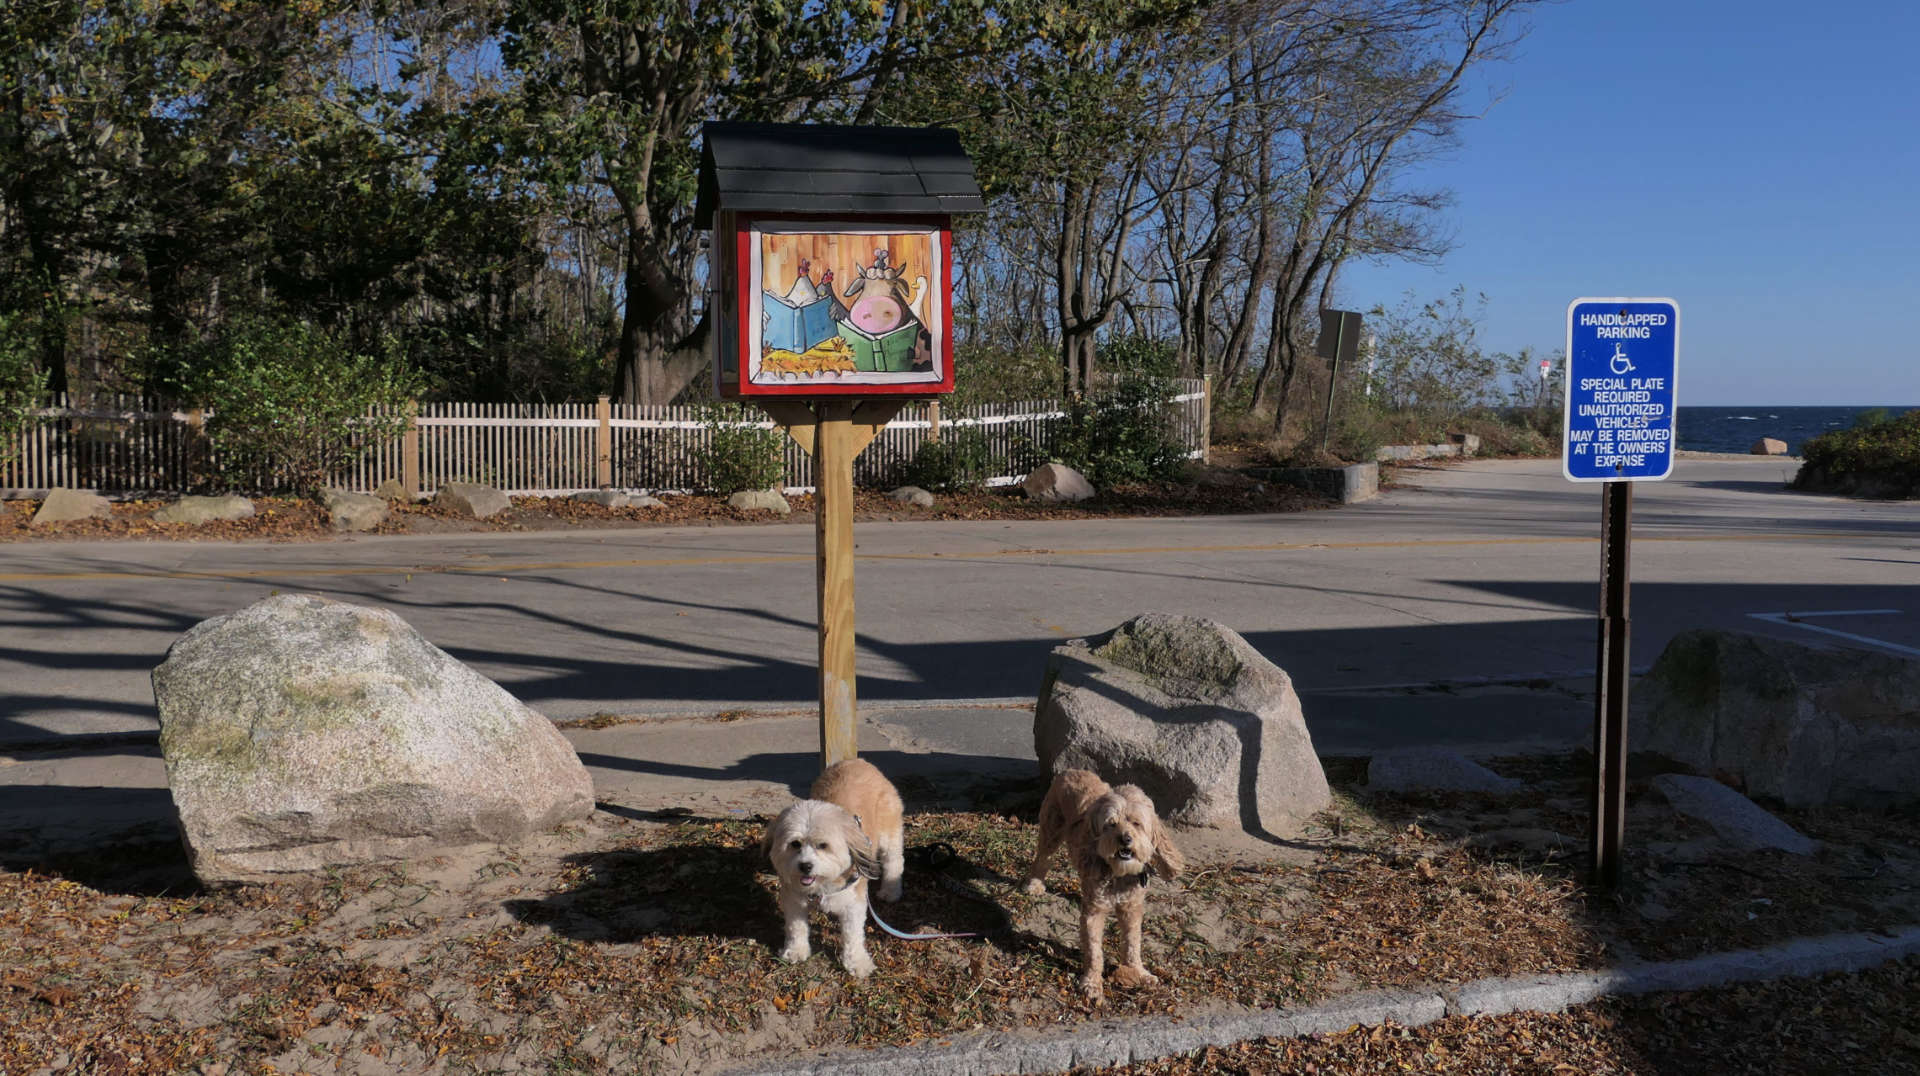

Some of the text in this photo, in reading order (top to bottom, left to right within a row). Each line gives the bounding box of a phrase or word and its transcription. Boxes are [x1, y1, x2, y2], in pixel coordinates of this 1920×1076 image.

[1580, 313, 1667, 326] HANDICAPPED
[1597, 327, 1650, 339] PARKING
[1580, 378, 1664, 391] SPECIAL PLATE
[1594, 391, 1650, 403] REQUIRED
[1579, 404, 1664, 416] UNAUTHORIZED
[1595, 416, 1648, 429] VEHICLES
[1570, 429, 1670, 442] MAY BE REMOVED
[1574, 442, 1665, 455] AT THE OWNERS
[1595, 455, 1645, 467] EXPENSE
